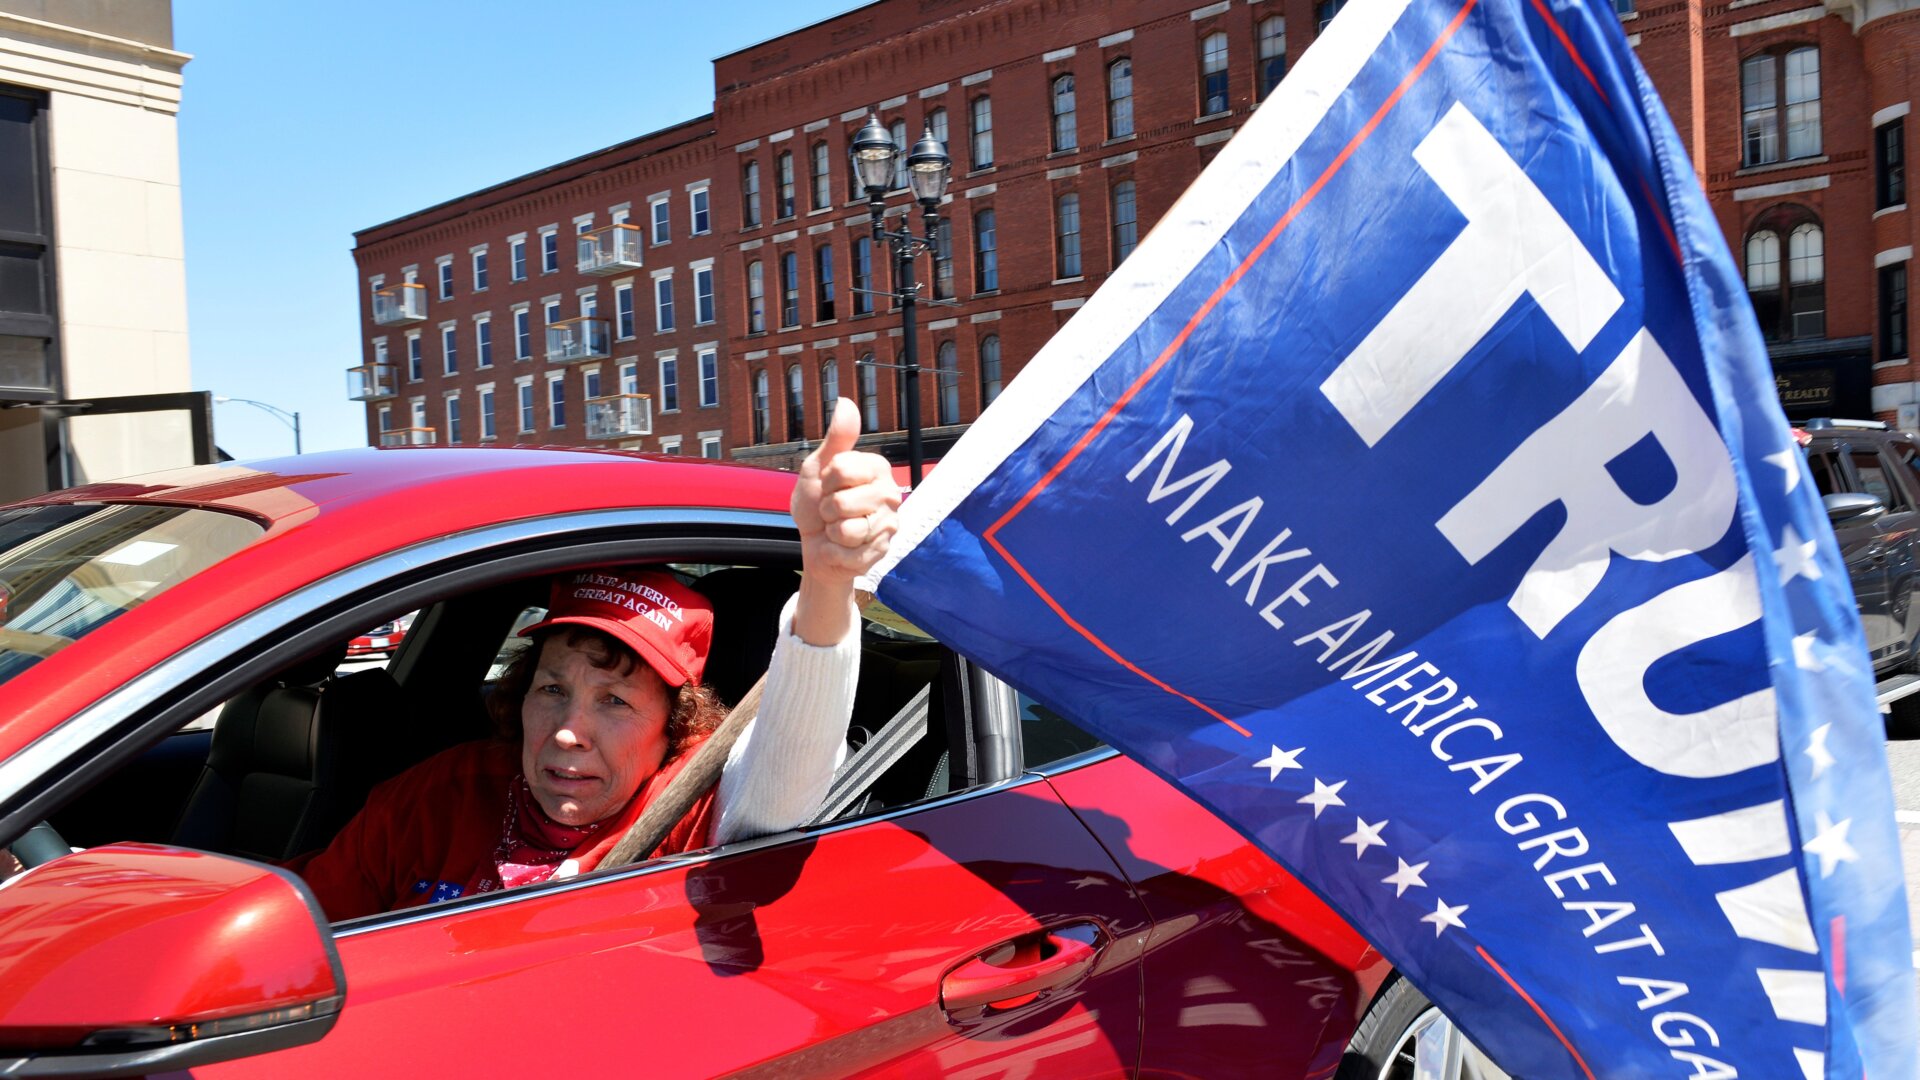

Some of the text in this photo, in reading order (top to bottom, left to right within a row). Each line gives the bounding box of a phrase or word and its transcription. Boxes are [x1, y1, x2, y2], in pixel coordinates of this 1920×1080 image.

[1786, 386, 1831, 400] REALTY
[573, 574, 684, 622] MAKE AMERICA
[573, 588, 674, 632] GREAT AGAIN
[1319, 99, 1825, 1080] TRU
[1125, 412, 1739, 1080] MAKE AMERICA GREAT AGA
